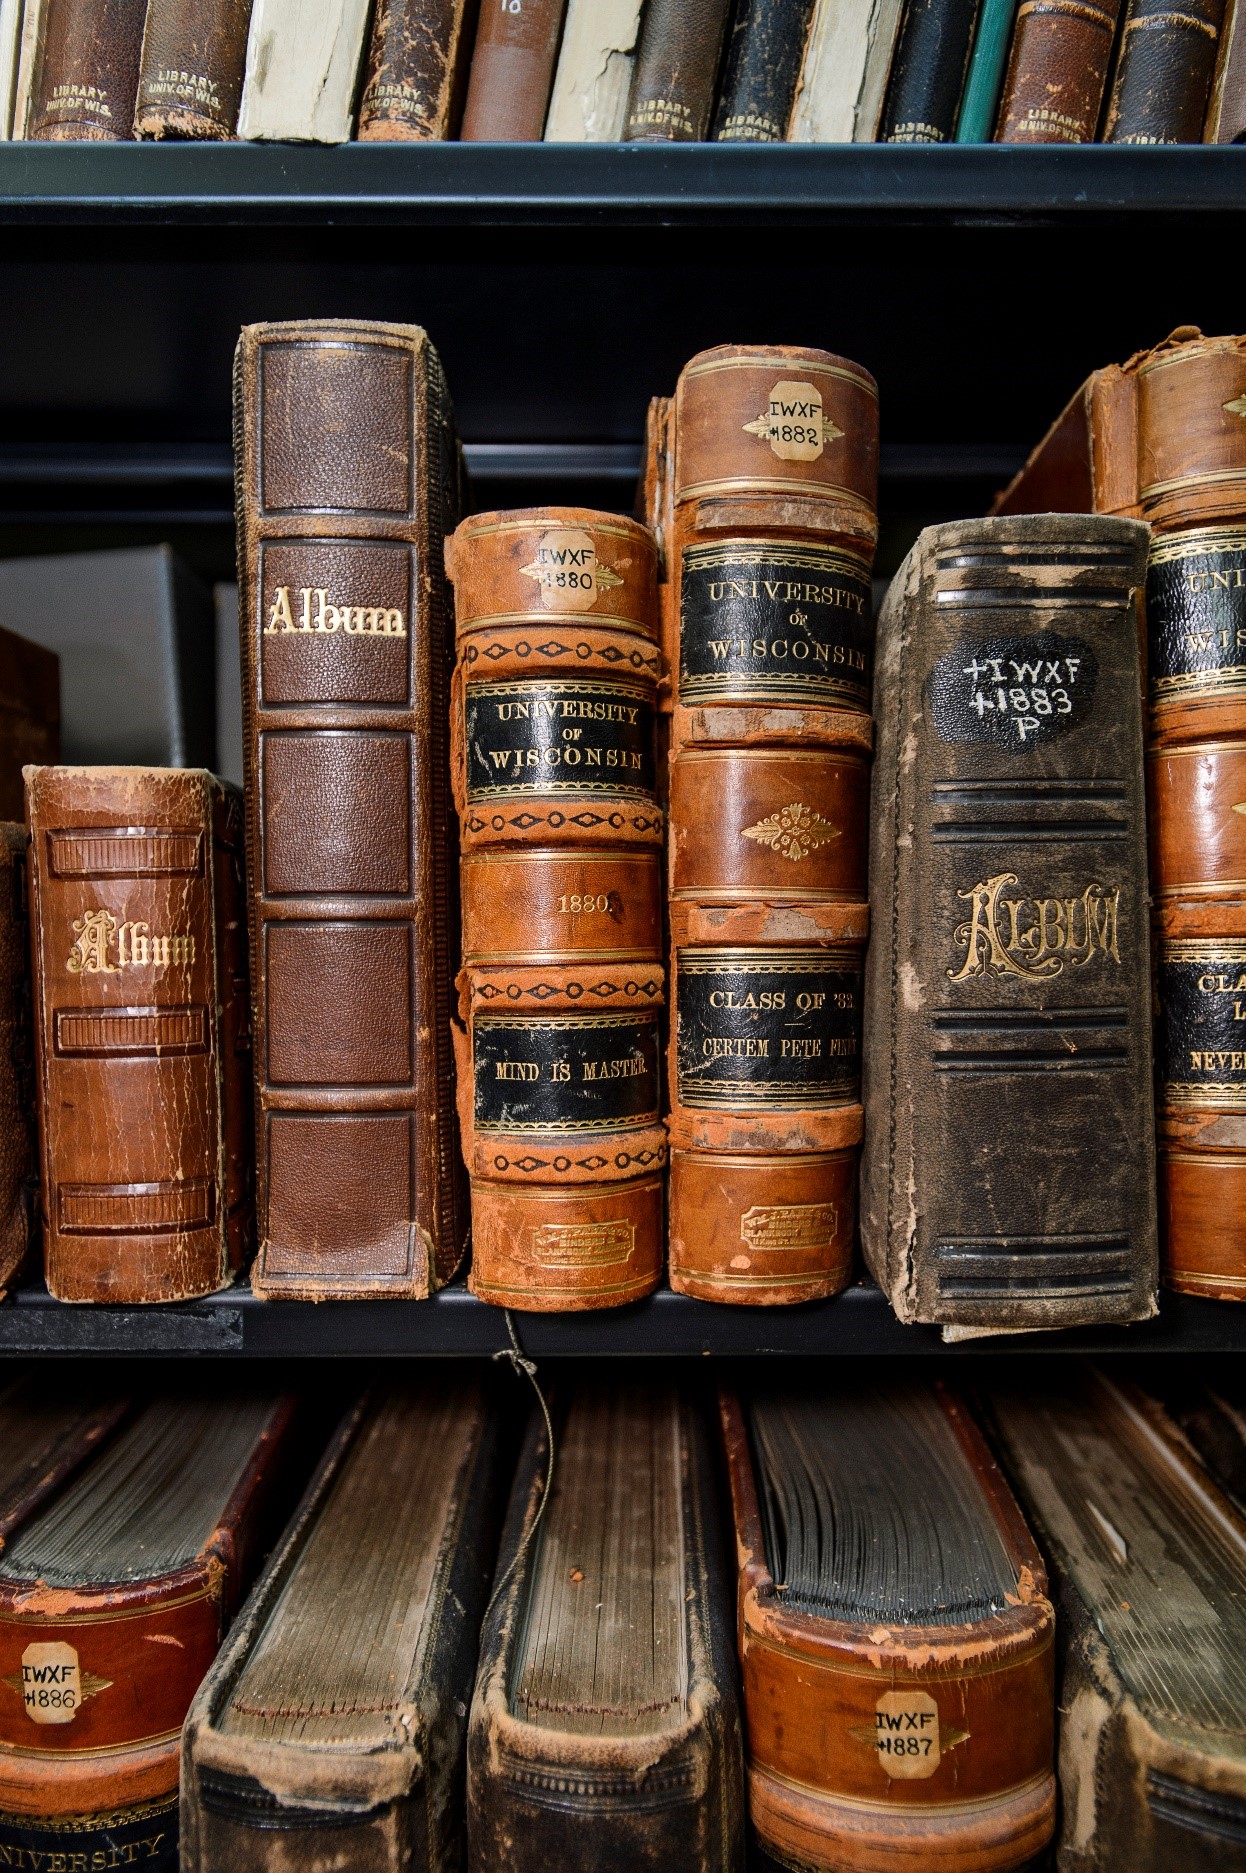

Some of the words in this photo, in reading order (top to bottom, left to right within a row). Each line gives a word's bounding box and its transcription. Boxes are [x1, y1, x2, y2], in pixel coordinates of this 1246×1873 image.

[158, 70, 218, 93] LIBRARY
[53, 84, 108, 101] LIBRARY
[368, 85, 421, 100] LIBRARY
[637, 100, 691, 117] LIBRARY
[770, 401, 822, 418] IWXF
[538, 548, 594, 566] IWXF
[709, 580, 865, 615] UNIVERSITY
[263, 585, 408, 637] Album
[789, 612, 808, 626] OF
[707, 639, 866, 672] WISCONSIN
[496, 700, 639, 725] UNIVERSITY
[562, 728, 583, 741] OF
[1011, 716, 1041, 741] P
[489, 748, 643, 770] WISCONSIN
[946, 872, 1122, 983] ALBUM
[66, 909, 196, 973] Album
[709, 990, 786, 1010] CLASS
[796, 992, 826, 1010] OF
[702, 1037, 770, 1057] CERTEM
[780, 1038, 822, 1057] PETE
[495, 1062, 540, 1081] MIND
[550, 1063, 571, 1082] IS
[582, 1057, 648, 1081] MASTER.
[1190, 1051, 1246, 1070] NEVE
[22, 1665, 76, 1684] IWXF
[875, 1712, 936, 1731] IWXF
